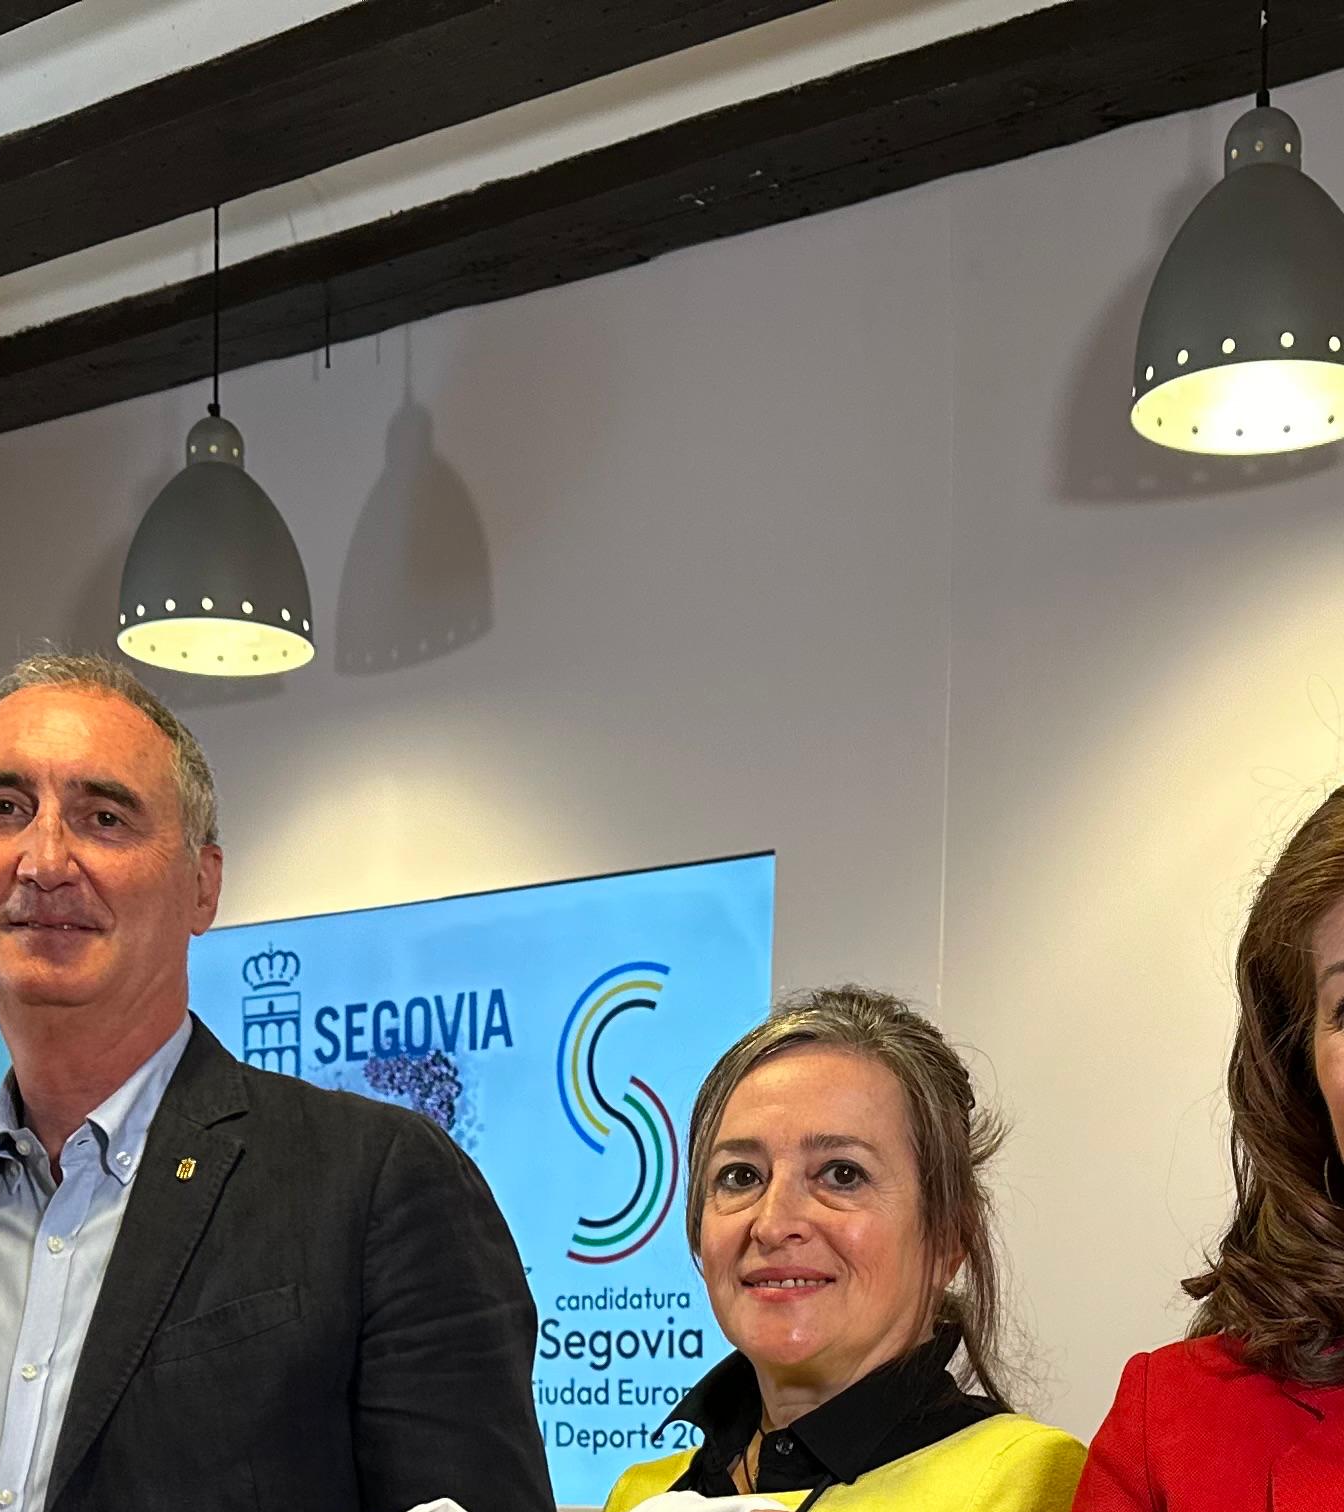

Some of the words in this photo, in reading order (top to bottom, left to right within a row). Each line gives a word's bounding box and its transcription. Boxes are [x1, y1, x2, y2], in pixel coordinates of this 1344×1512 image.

[314, 989, 513, 1064] SEGOVIA
[556, 1288, 691, 1312] candidatura
[540, 1317, 704, 1370] Segovia
[532, 1378, 610, 1405] iudad
[619, 1379, 689, 1405] Euro
[557, 1422, 664, 1454] Deporte
